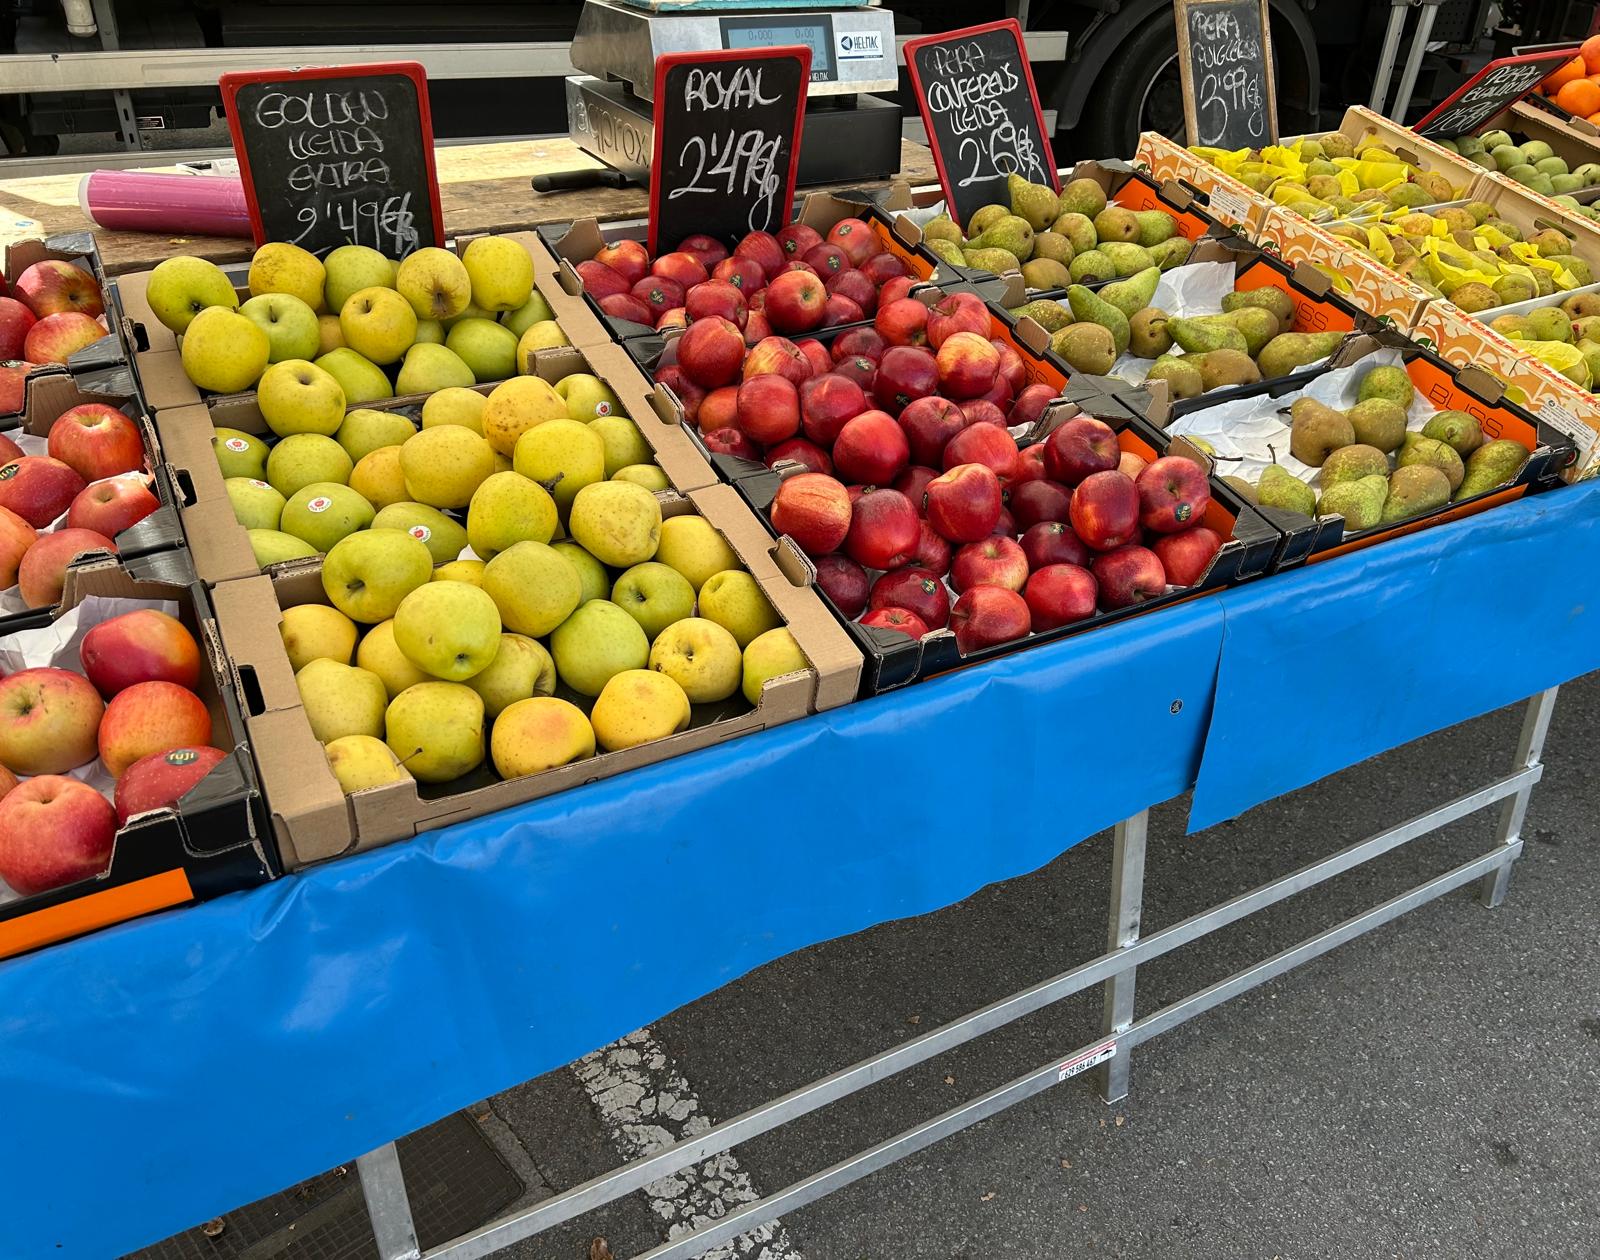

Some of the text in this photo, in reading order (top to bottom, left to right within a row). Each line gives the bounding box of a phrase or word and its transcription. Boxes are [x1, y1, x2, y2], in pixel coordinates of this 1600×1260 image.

[684, 65, 782, 112] ROYAL
[255, 89, 389, 129] GOLDEN
[950, 99, 1009, 136] LLEIDA
[287, 157, 390, 191] EXTRA
